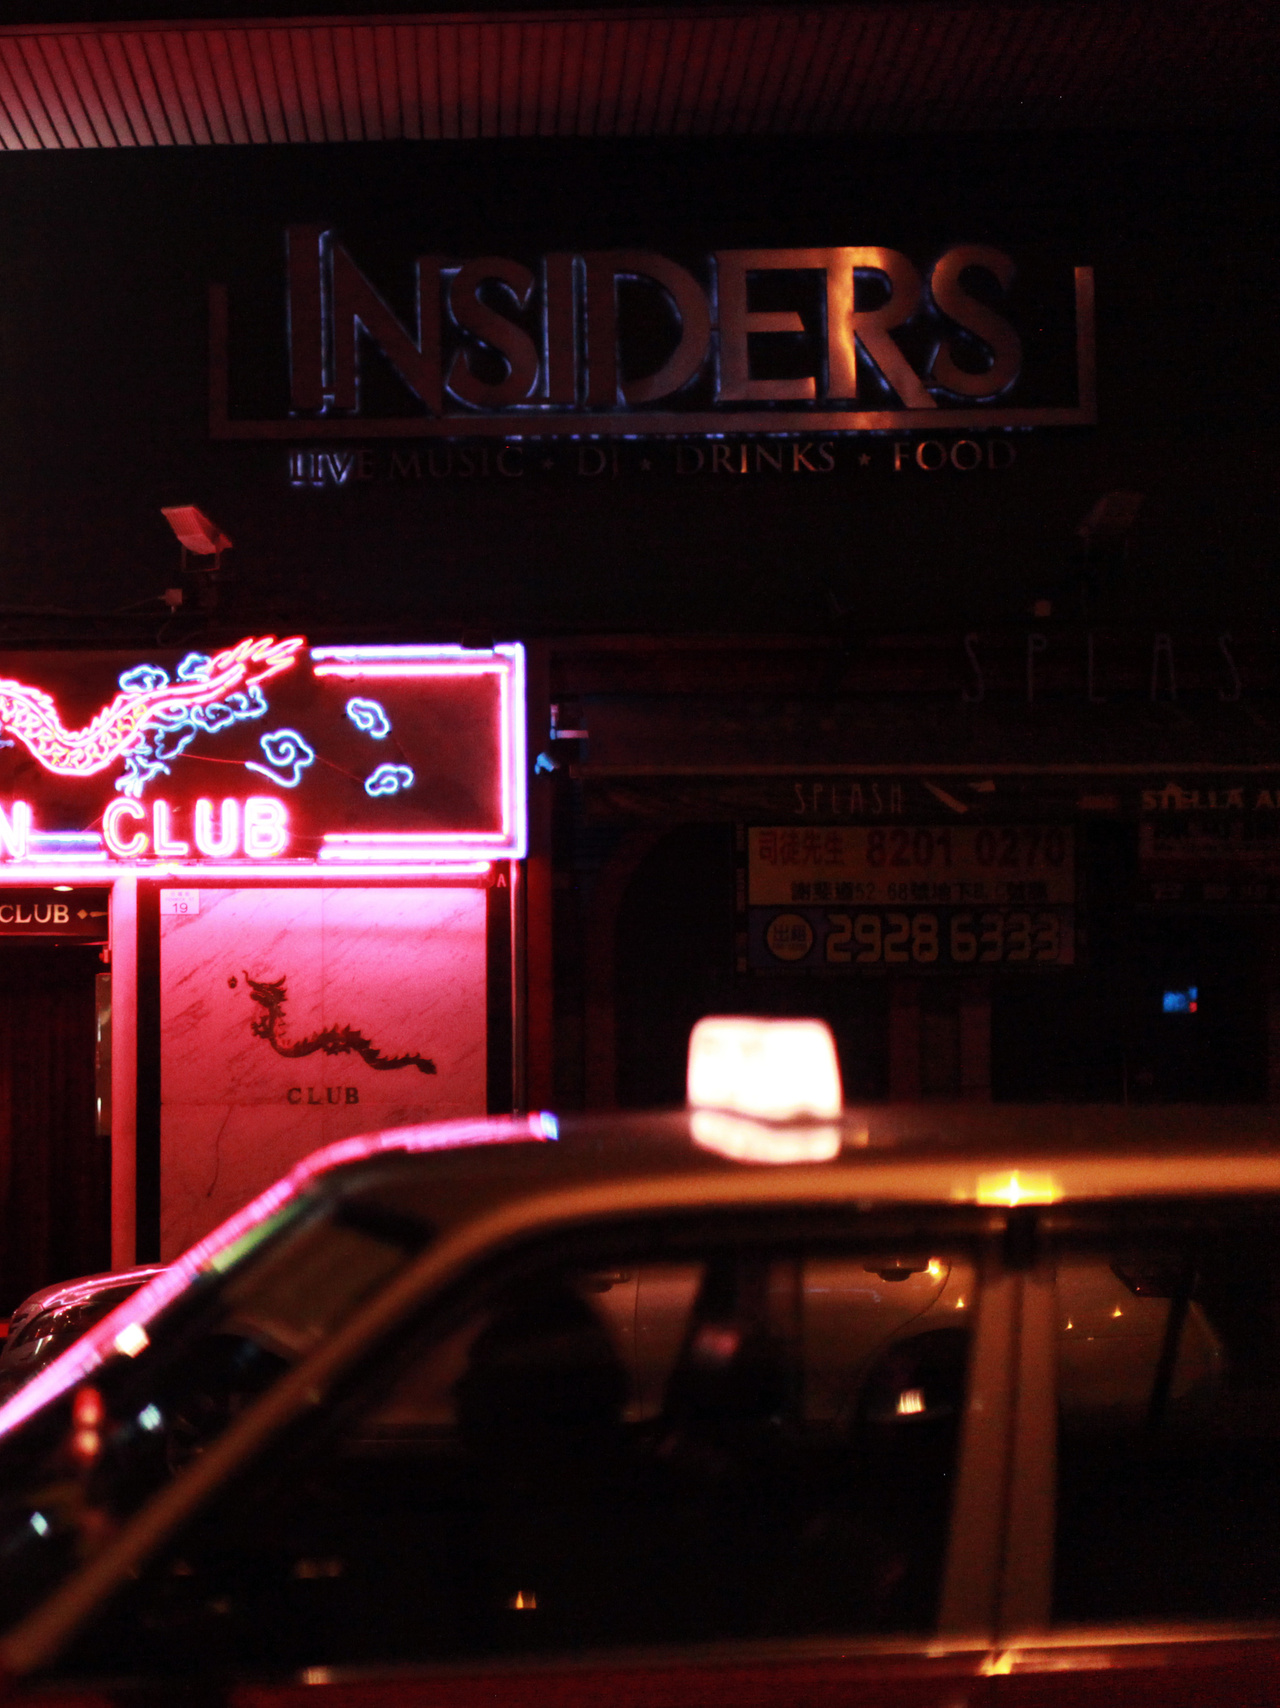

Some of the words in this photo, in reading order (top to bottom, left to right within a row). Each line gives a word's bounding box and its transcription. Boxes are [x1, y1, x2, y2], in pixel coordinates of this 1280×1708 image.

[287, 226, 1020, 418] INSIDERS
[290, 448, 374, 481] LIVE
[388, 446, 525, 478] MUSIC
[577, 447, 620, 479] DJ
[676, 441, 836, 475] DRINKS
[893, 439, 1018, 472] FOOD
[102, 796, 292, 862] CLUB
[864, 828, 953, 868] 8201
[974, 828, 1067, 868] 0270
[172, 902, 188, 914] 19
[825, 912, 940, 963] 2928
[949, 911, 1060, 963] 6333
[286, 1086, 360, 1106] CLUB
